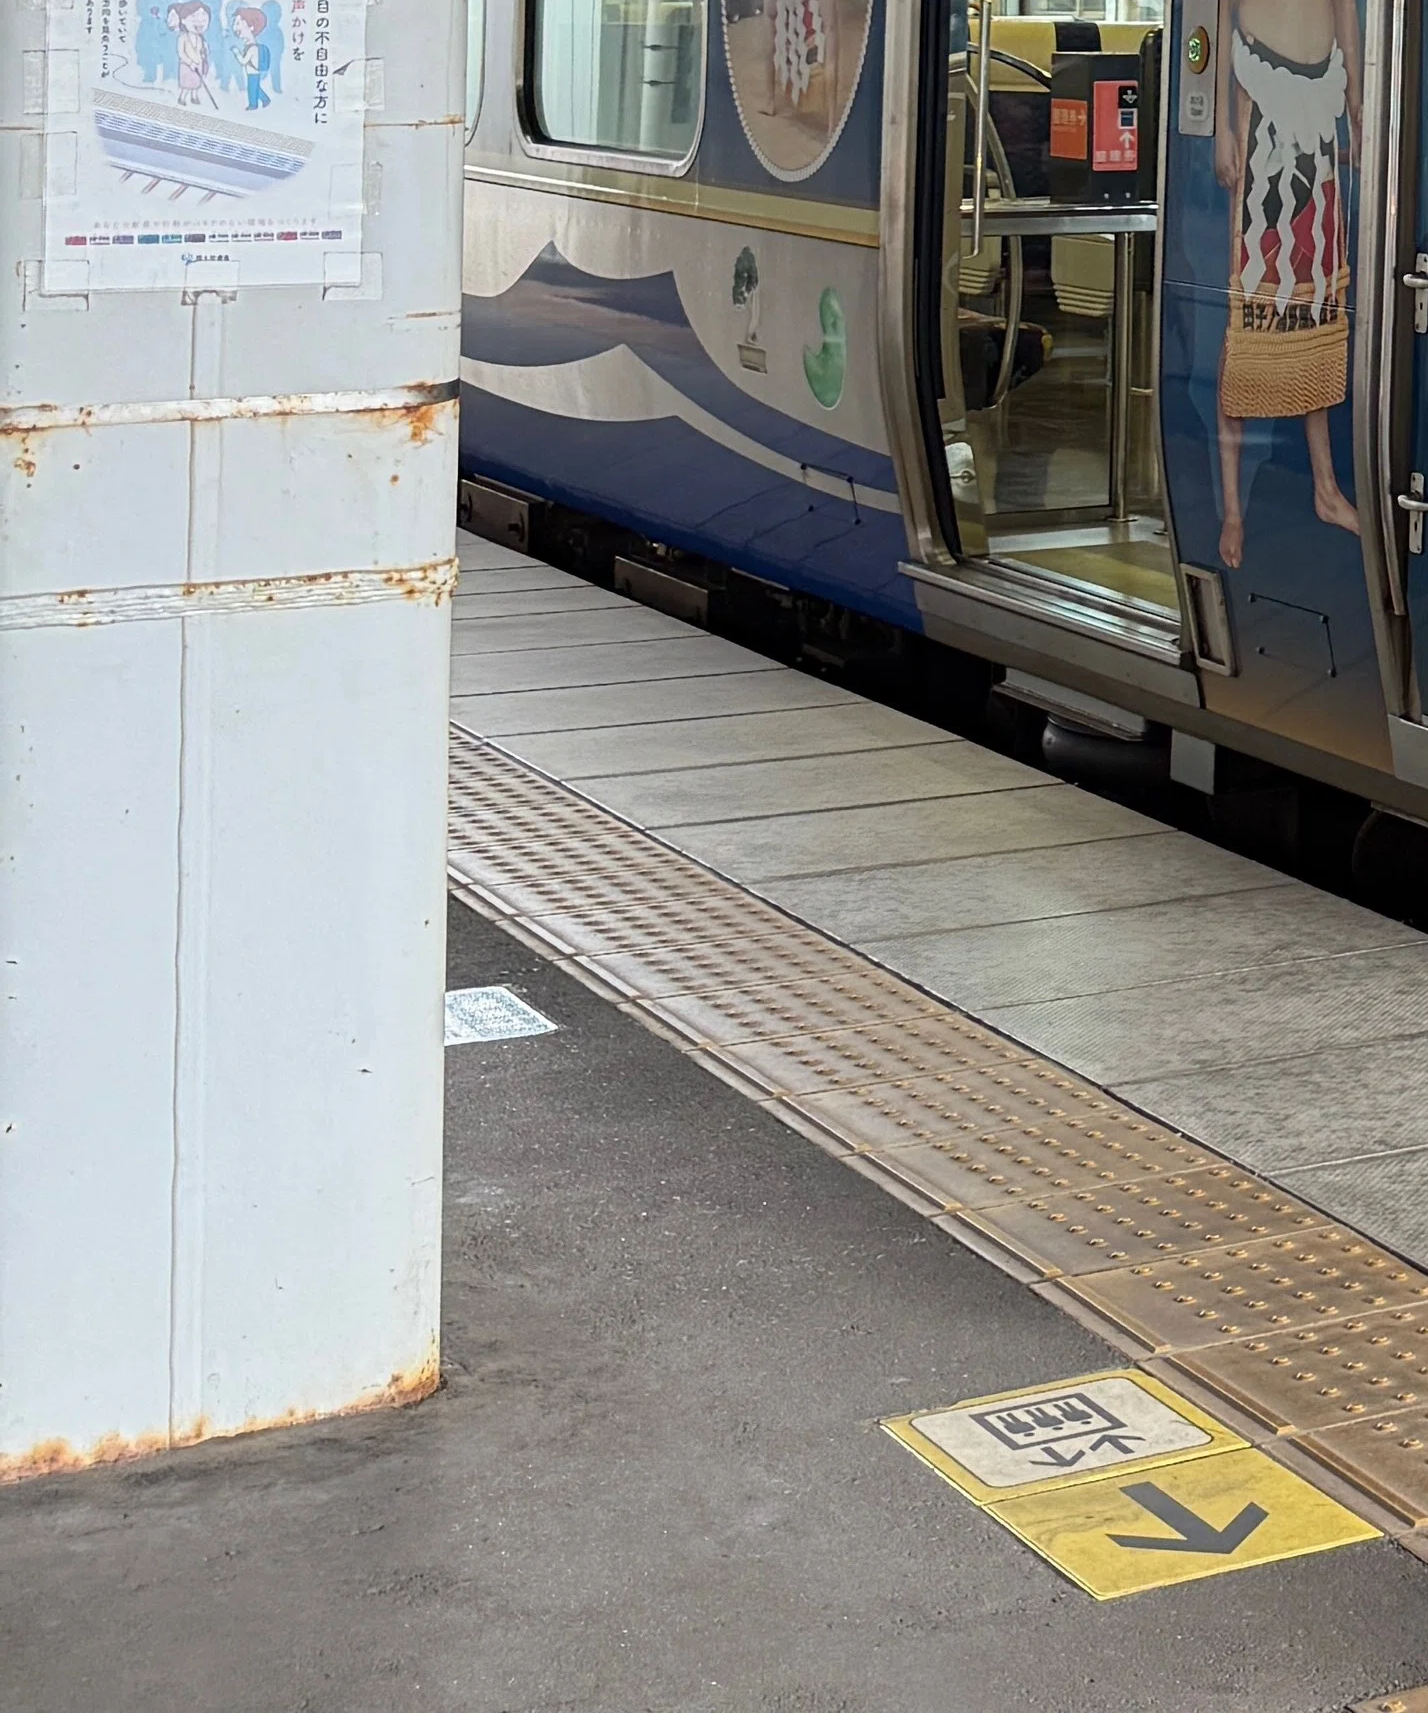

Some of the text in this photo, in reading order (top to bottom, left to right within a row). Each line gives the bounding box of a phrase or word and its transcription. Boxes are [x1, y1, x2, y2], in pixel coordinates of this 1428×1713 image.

[313, 0, 330, 124] 目の不自由な方に
